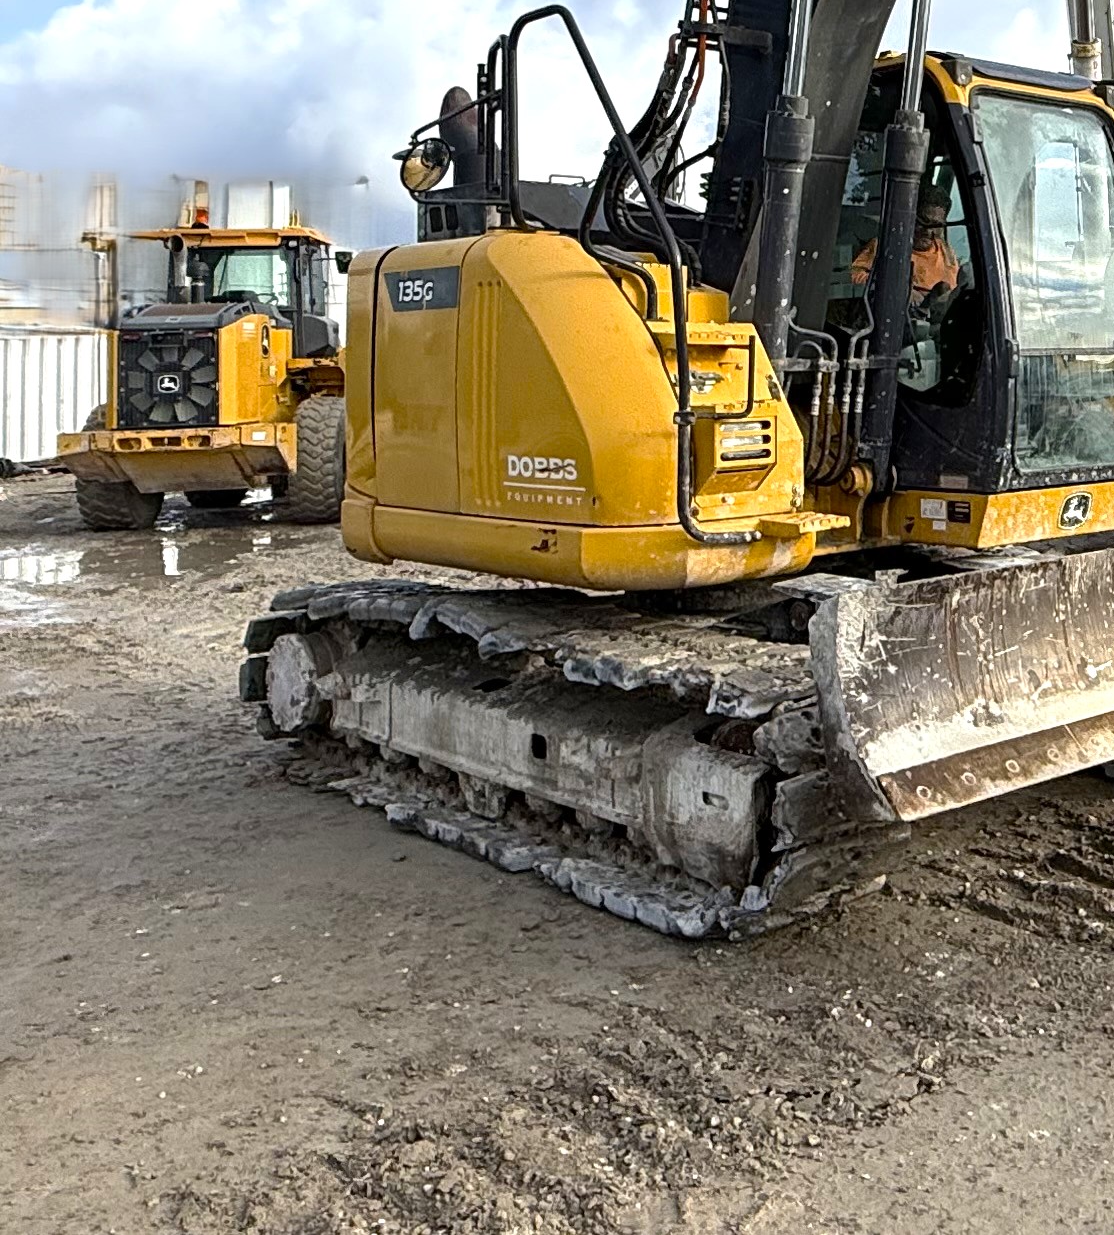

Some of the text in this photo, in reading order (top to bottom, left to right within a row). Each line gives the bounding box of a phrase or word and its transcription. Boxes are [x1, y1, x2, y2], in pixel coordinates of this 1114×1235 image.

[398, 280, 433, 302] 135G
[507, 455, 577, 480] DOBBS
[507, 491, 582, 505] EQUIPMENT
